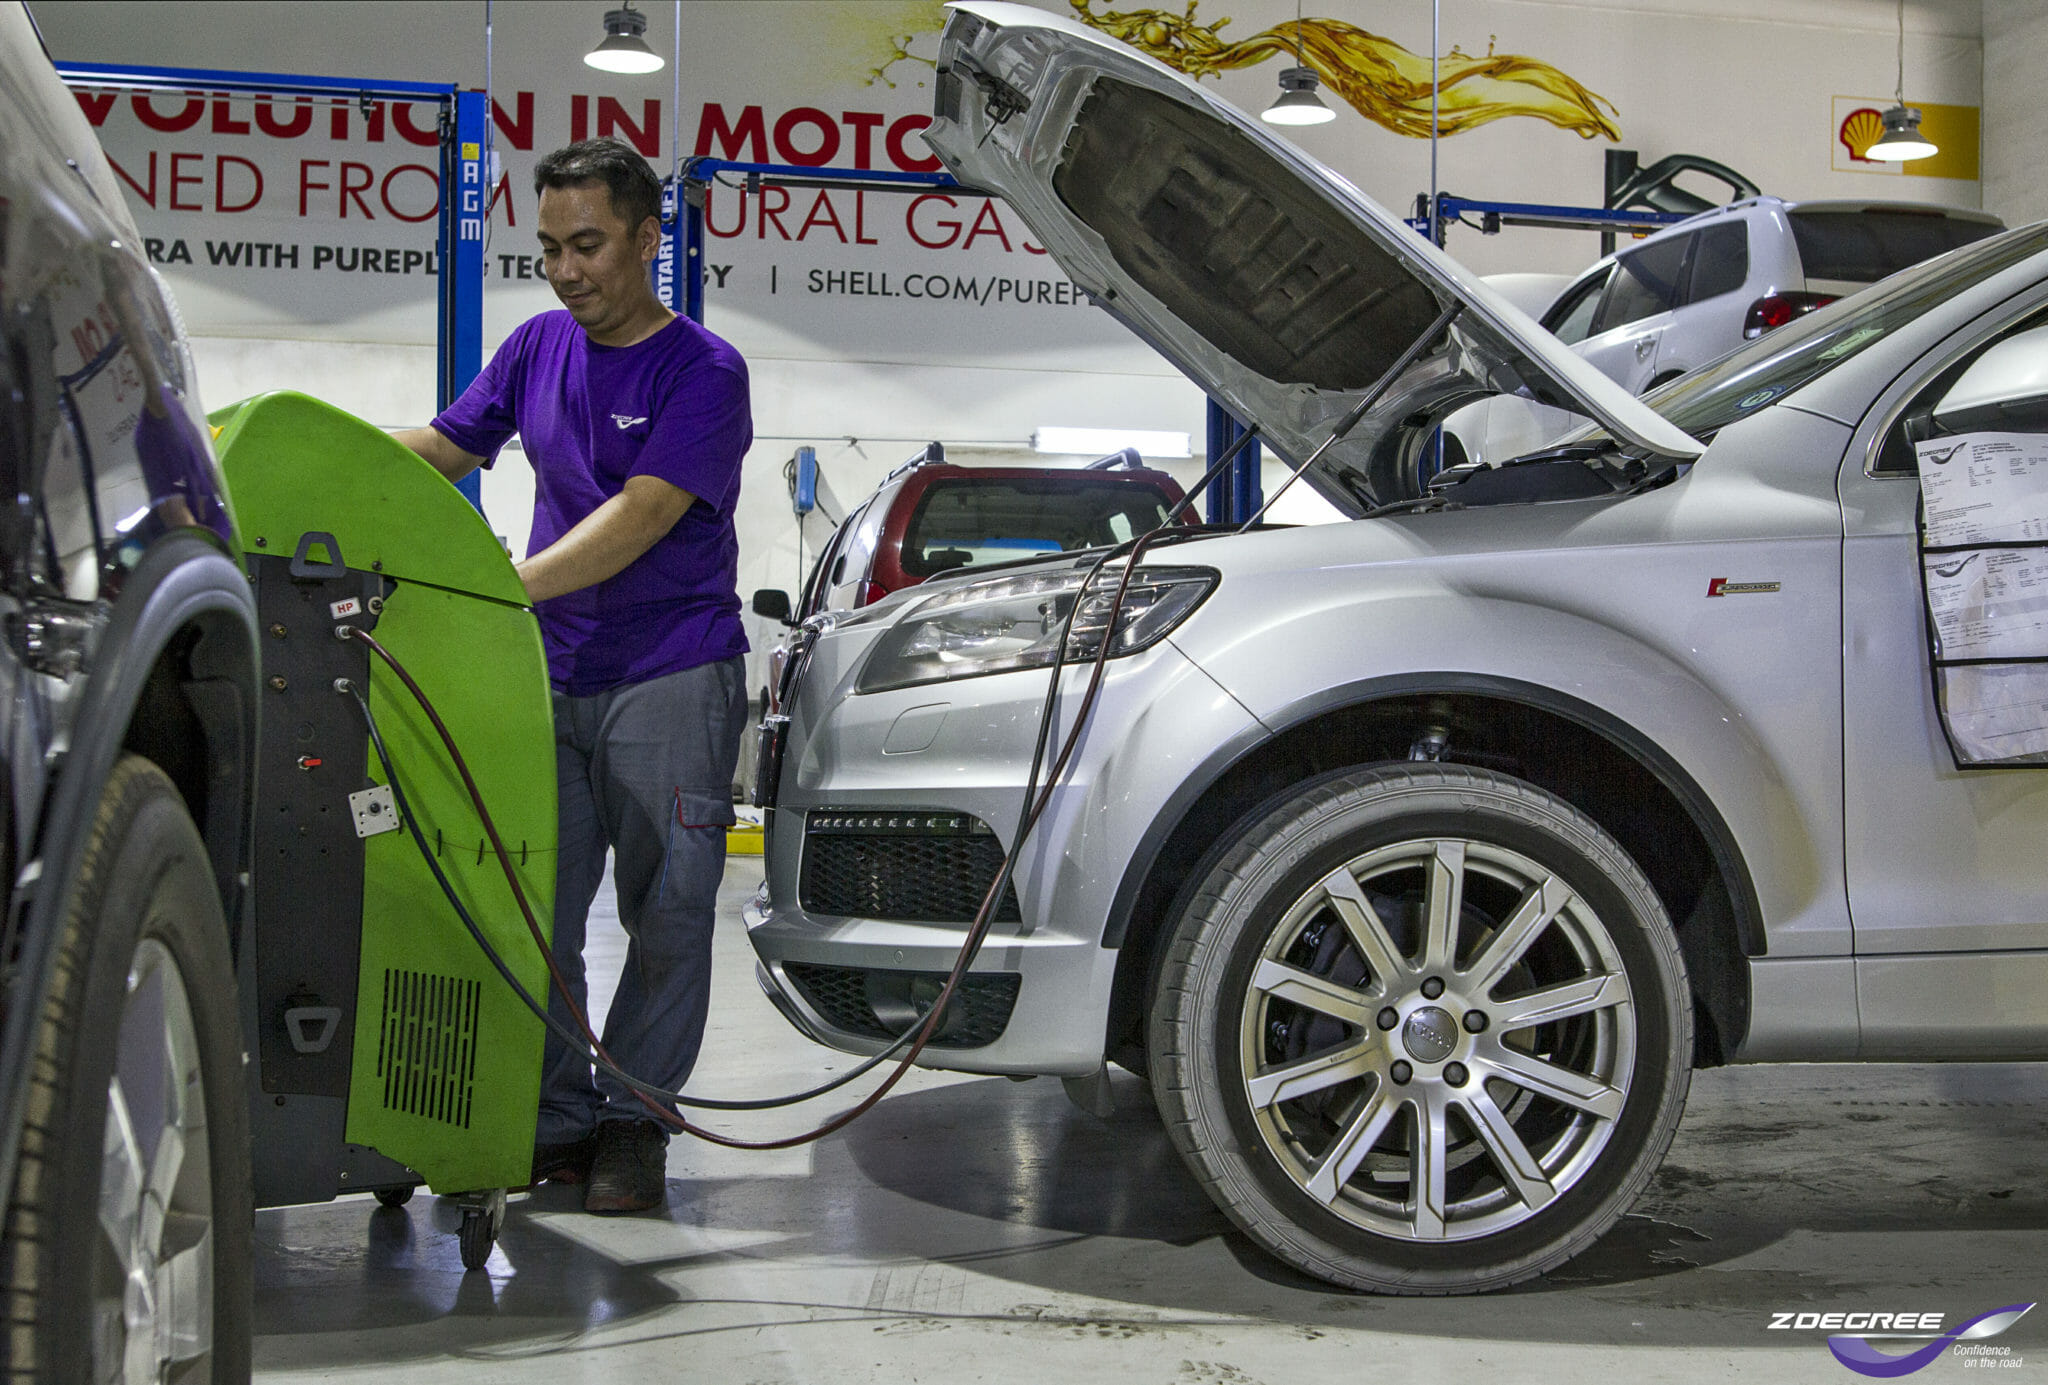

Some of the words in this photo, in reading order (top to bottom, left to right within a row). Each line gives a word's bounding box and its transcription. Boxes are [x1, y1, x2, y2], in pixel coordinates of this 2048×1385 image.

[571, 95, 661, 158] IN
[460, 162, 481, 241] AGM
[141, 238, 192, 265] RA
[205, 240, 299, 269] WITH
[337, 602, 354, 614] HP
